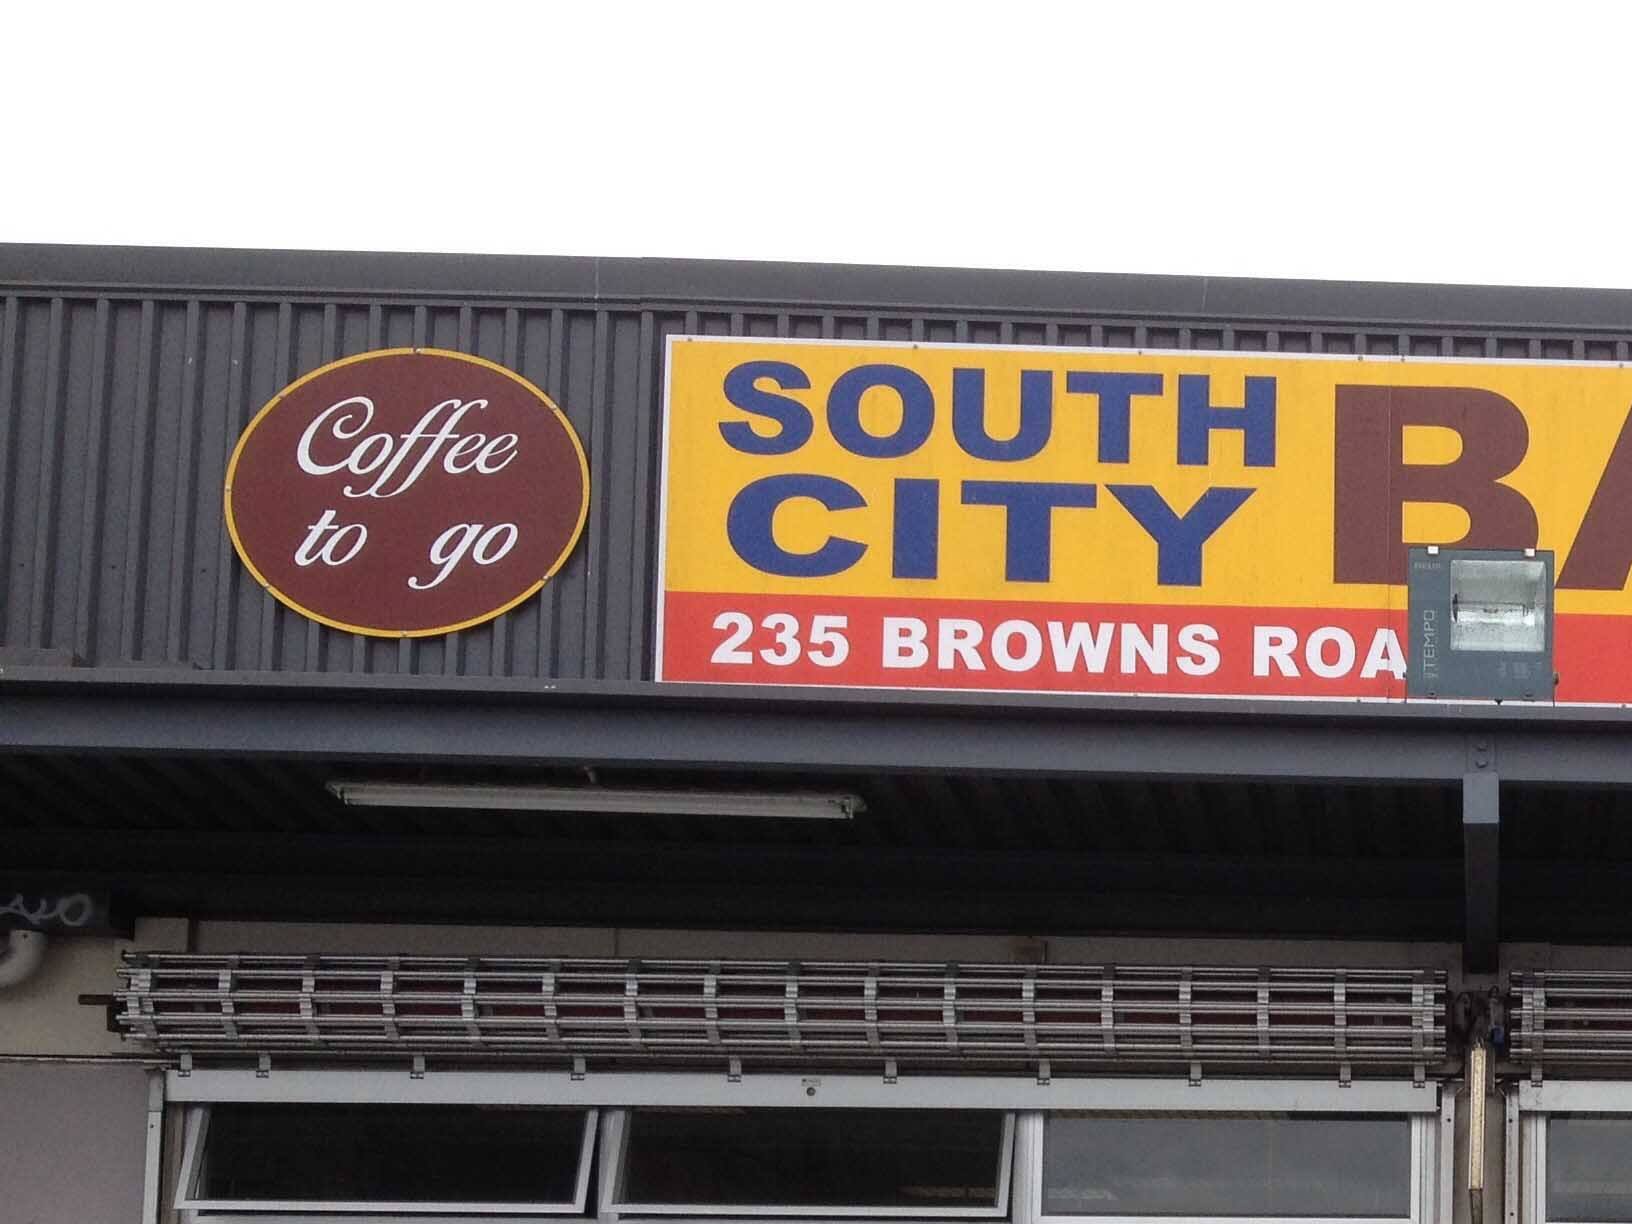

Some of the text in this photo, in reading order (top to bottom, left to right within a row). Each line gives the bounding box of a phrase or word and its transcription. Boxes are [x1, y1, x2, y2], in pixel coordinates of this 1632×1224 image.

[296, 396, 518, 499] Coffee
[718, 361, 1277, 467] SOUTH
[294, 509, 518, 590] to go
[726, 473, 1257, 587] CITY
[711, 612, 1409, 681] 235 BROWNS ROA
